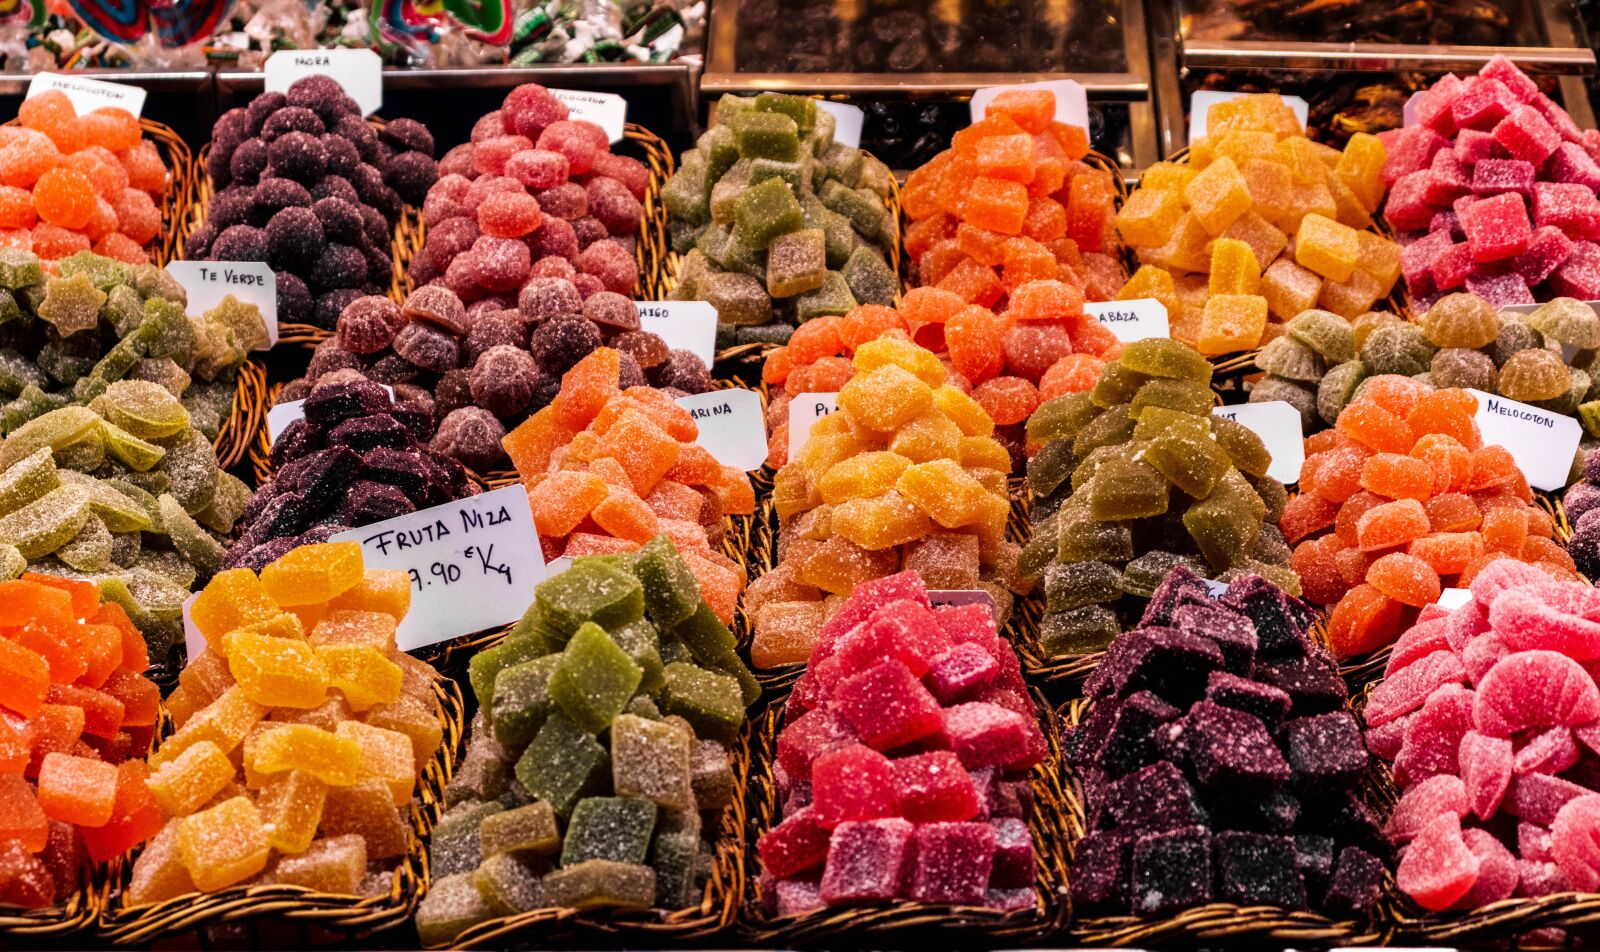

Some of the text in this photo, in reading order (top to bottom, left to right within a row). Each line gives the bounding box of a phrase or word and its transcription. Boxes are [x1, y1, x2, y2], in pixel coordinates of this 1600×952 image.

[224, 269, 264, 286] VERDE
[363, 505, 511, 556] FRUTA NIZA
